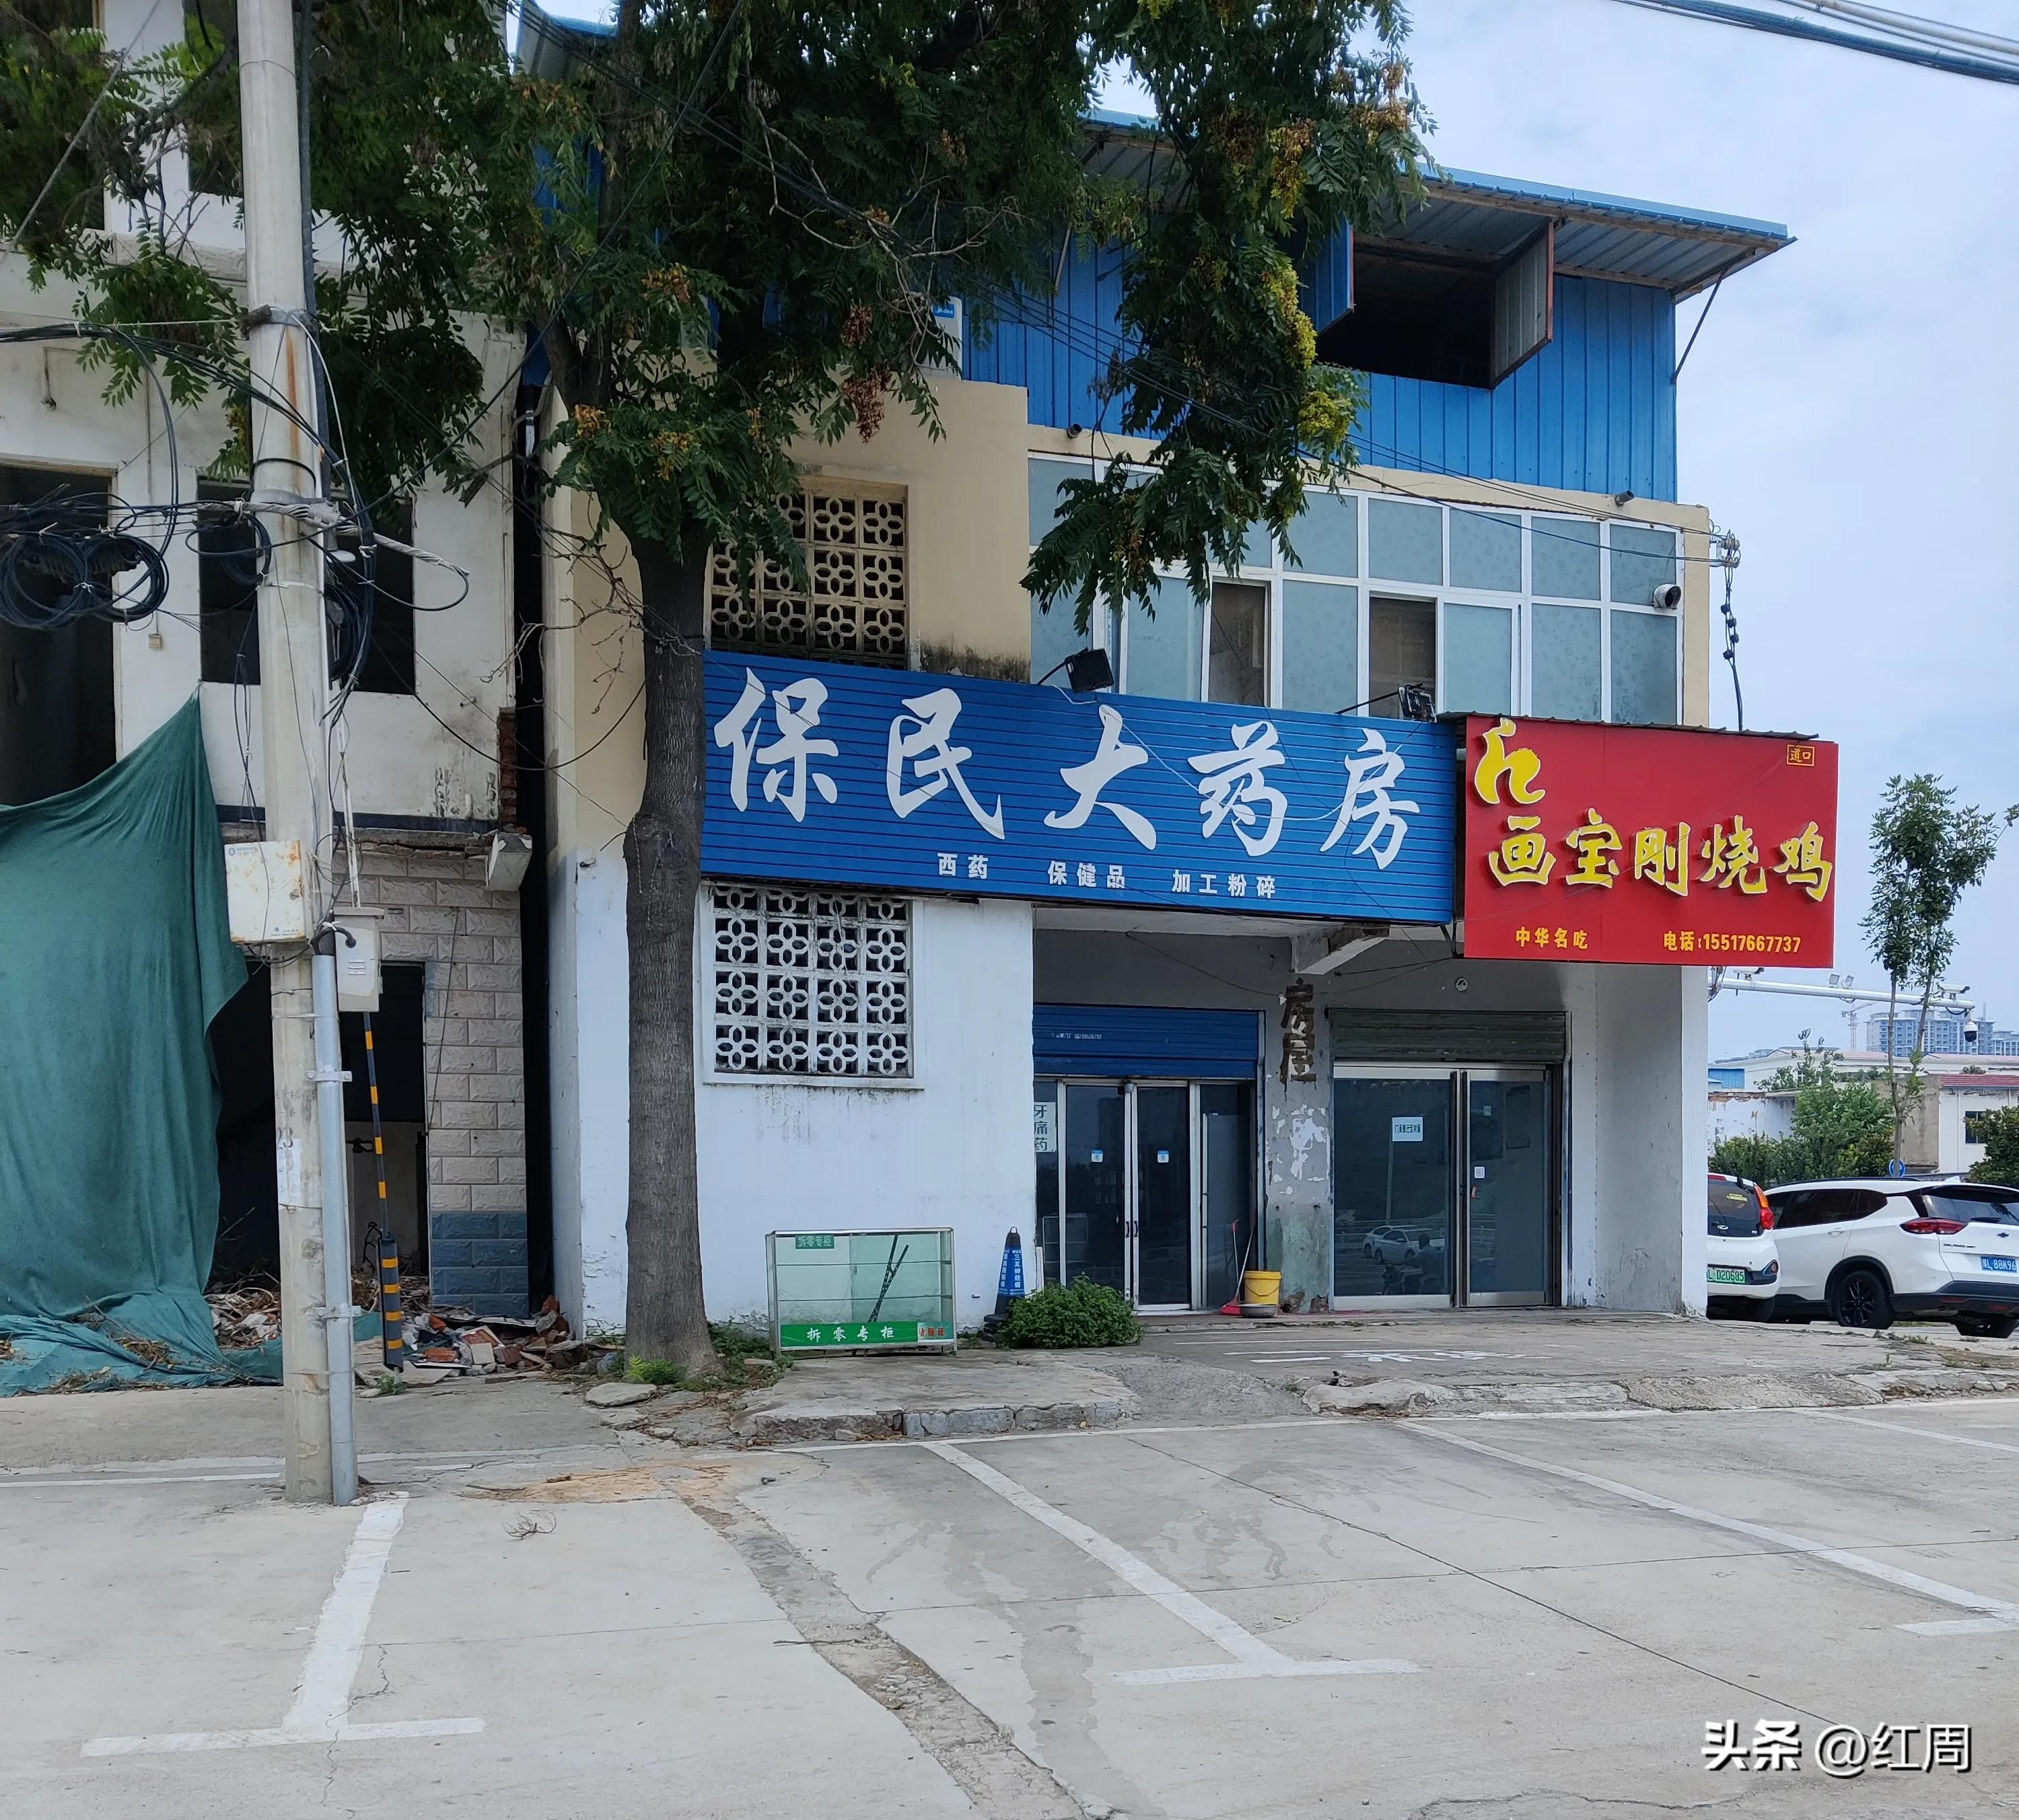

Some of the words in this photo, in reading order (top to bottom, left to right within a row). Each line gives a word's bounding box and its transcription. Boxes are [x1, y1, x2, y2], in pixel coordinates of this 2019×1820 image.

[713, 667, 1421, 871] 保民大药房
[1789, 748, 1812, 763] 道口
[1489, 807, 1834, 903] 画宝刚烧鸡
[937, 852, 989, 879] 西药
[1047, 861, 1125, 889] 保健品
[1171, 869, 1276, 899] 加工粉碎
[1516, 926, 1588, 949] 中华名吃
[1034, 1104, 1049, 1151] 牙痛药
[798, 1235, 832, 1247] 拆零专柜
[806, 1325, 895, 1343] 拆零专柜
